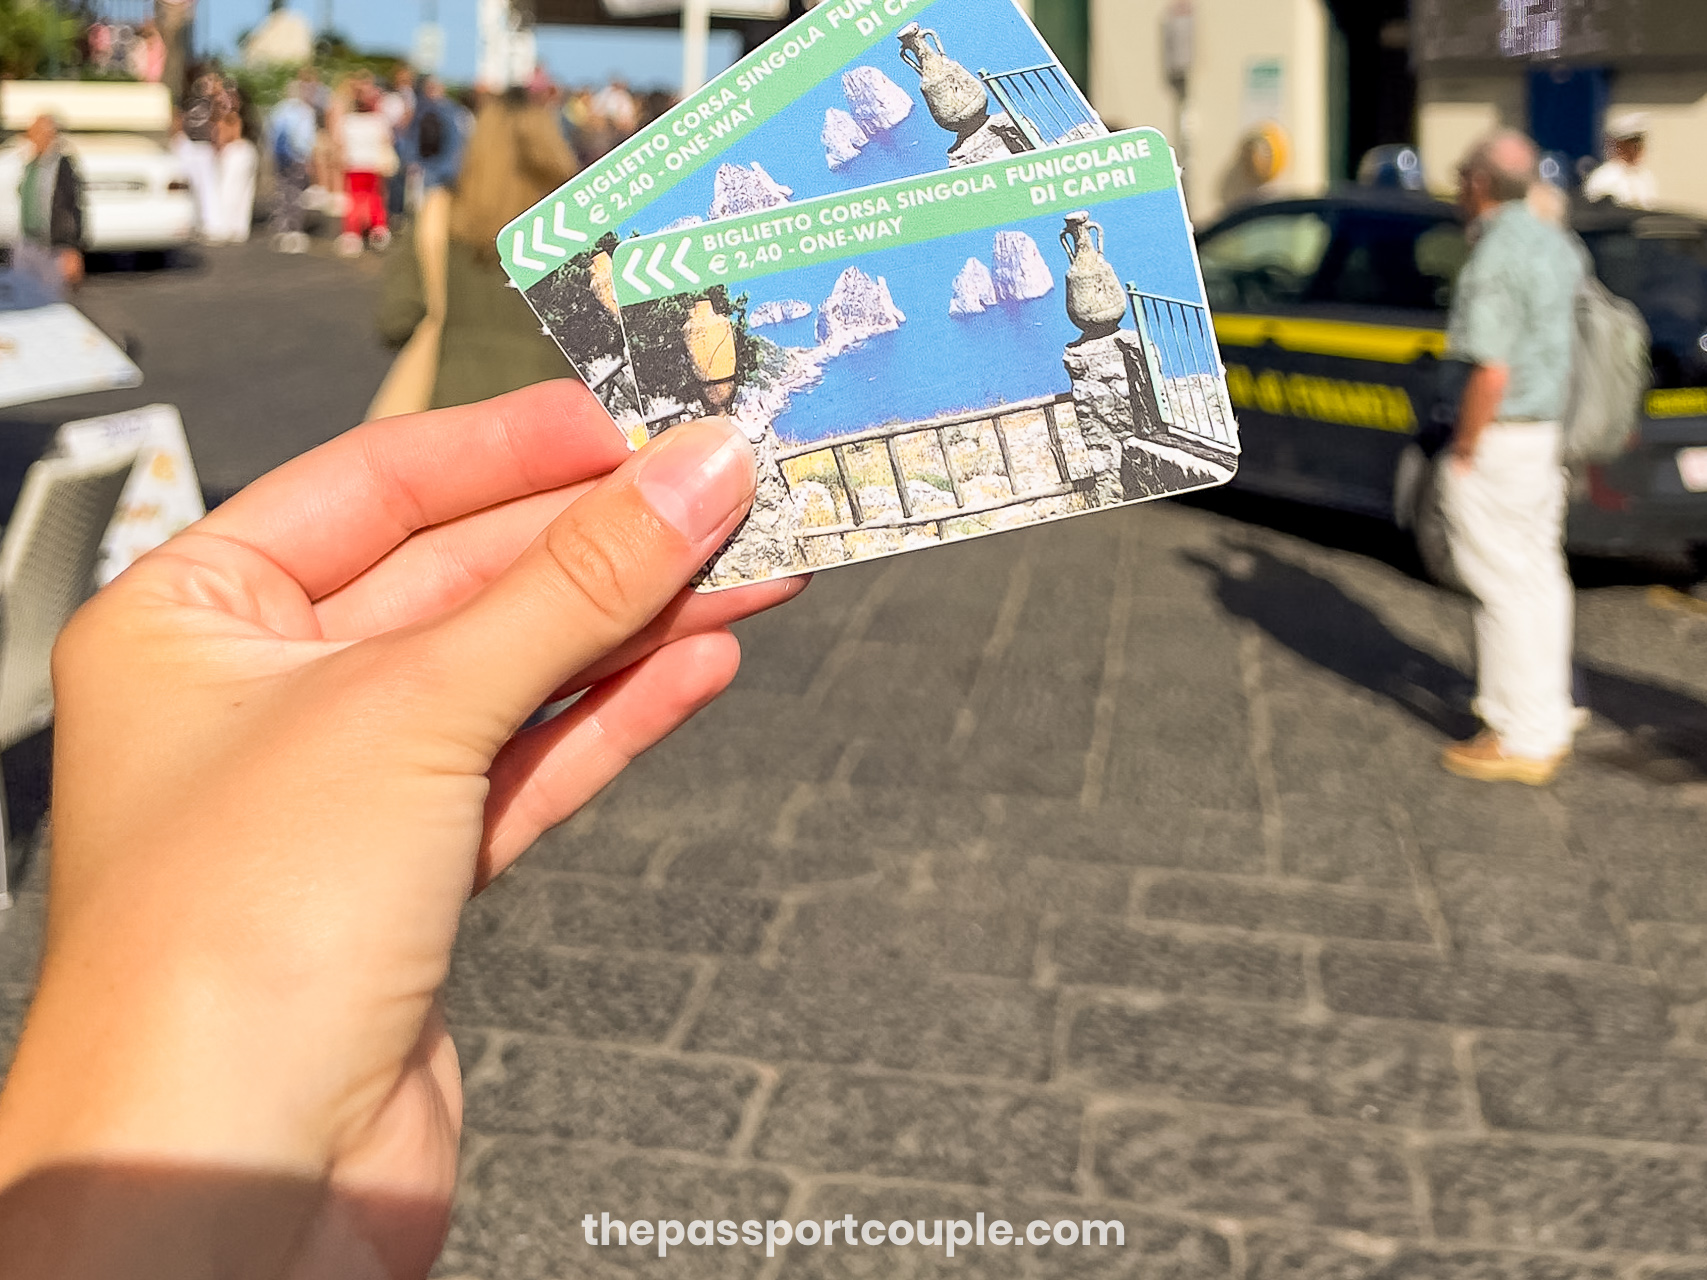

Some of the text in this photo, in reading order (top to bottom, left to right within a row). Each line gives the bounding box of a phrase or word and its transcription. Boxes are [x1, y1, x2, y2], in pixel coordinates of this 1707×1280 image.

[855, 10, 883, 37] DI
[573, 133, 670, 208] BIGLIETTO
[672, 87, 738, 137] CORSA
[736, 25, 825, 92] SINGOLA
[589, 203, 610, 225] €
[610, 172, 654, 211] 2,40
[664, 98, 755, 171] ONE-WAY
[702, 138, 1151, 252] BIGLIETTO CORSA SINGOLA FUNICOLARE
[1029, 166, 1137, 206] DI CAPRI
[708, 253, 729, 275] €
[734, 242, 782, 270] 2,40
[799, 215, 902, 255] ONE-WAY
